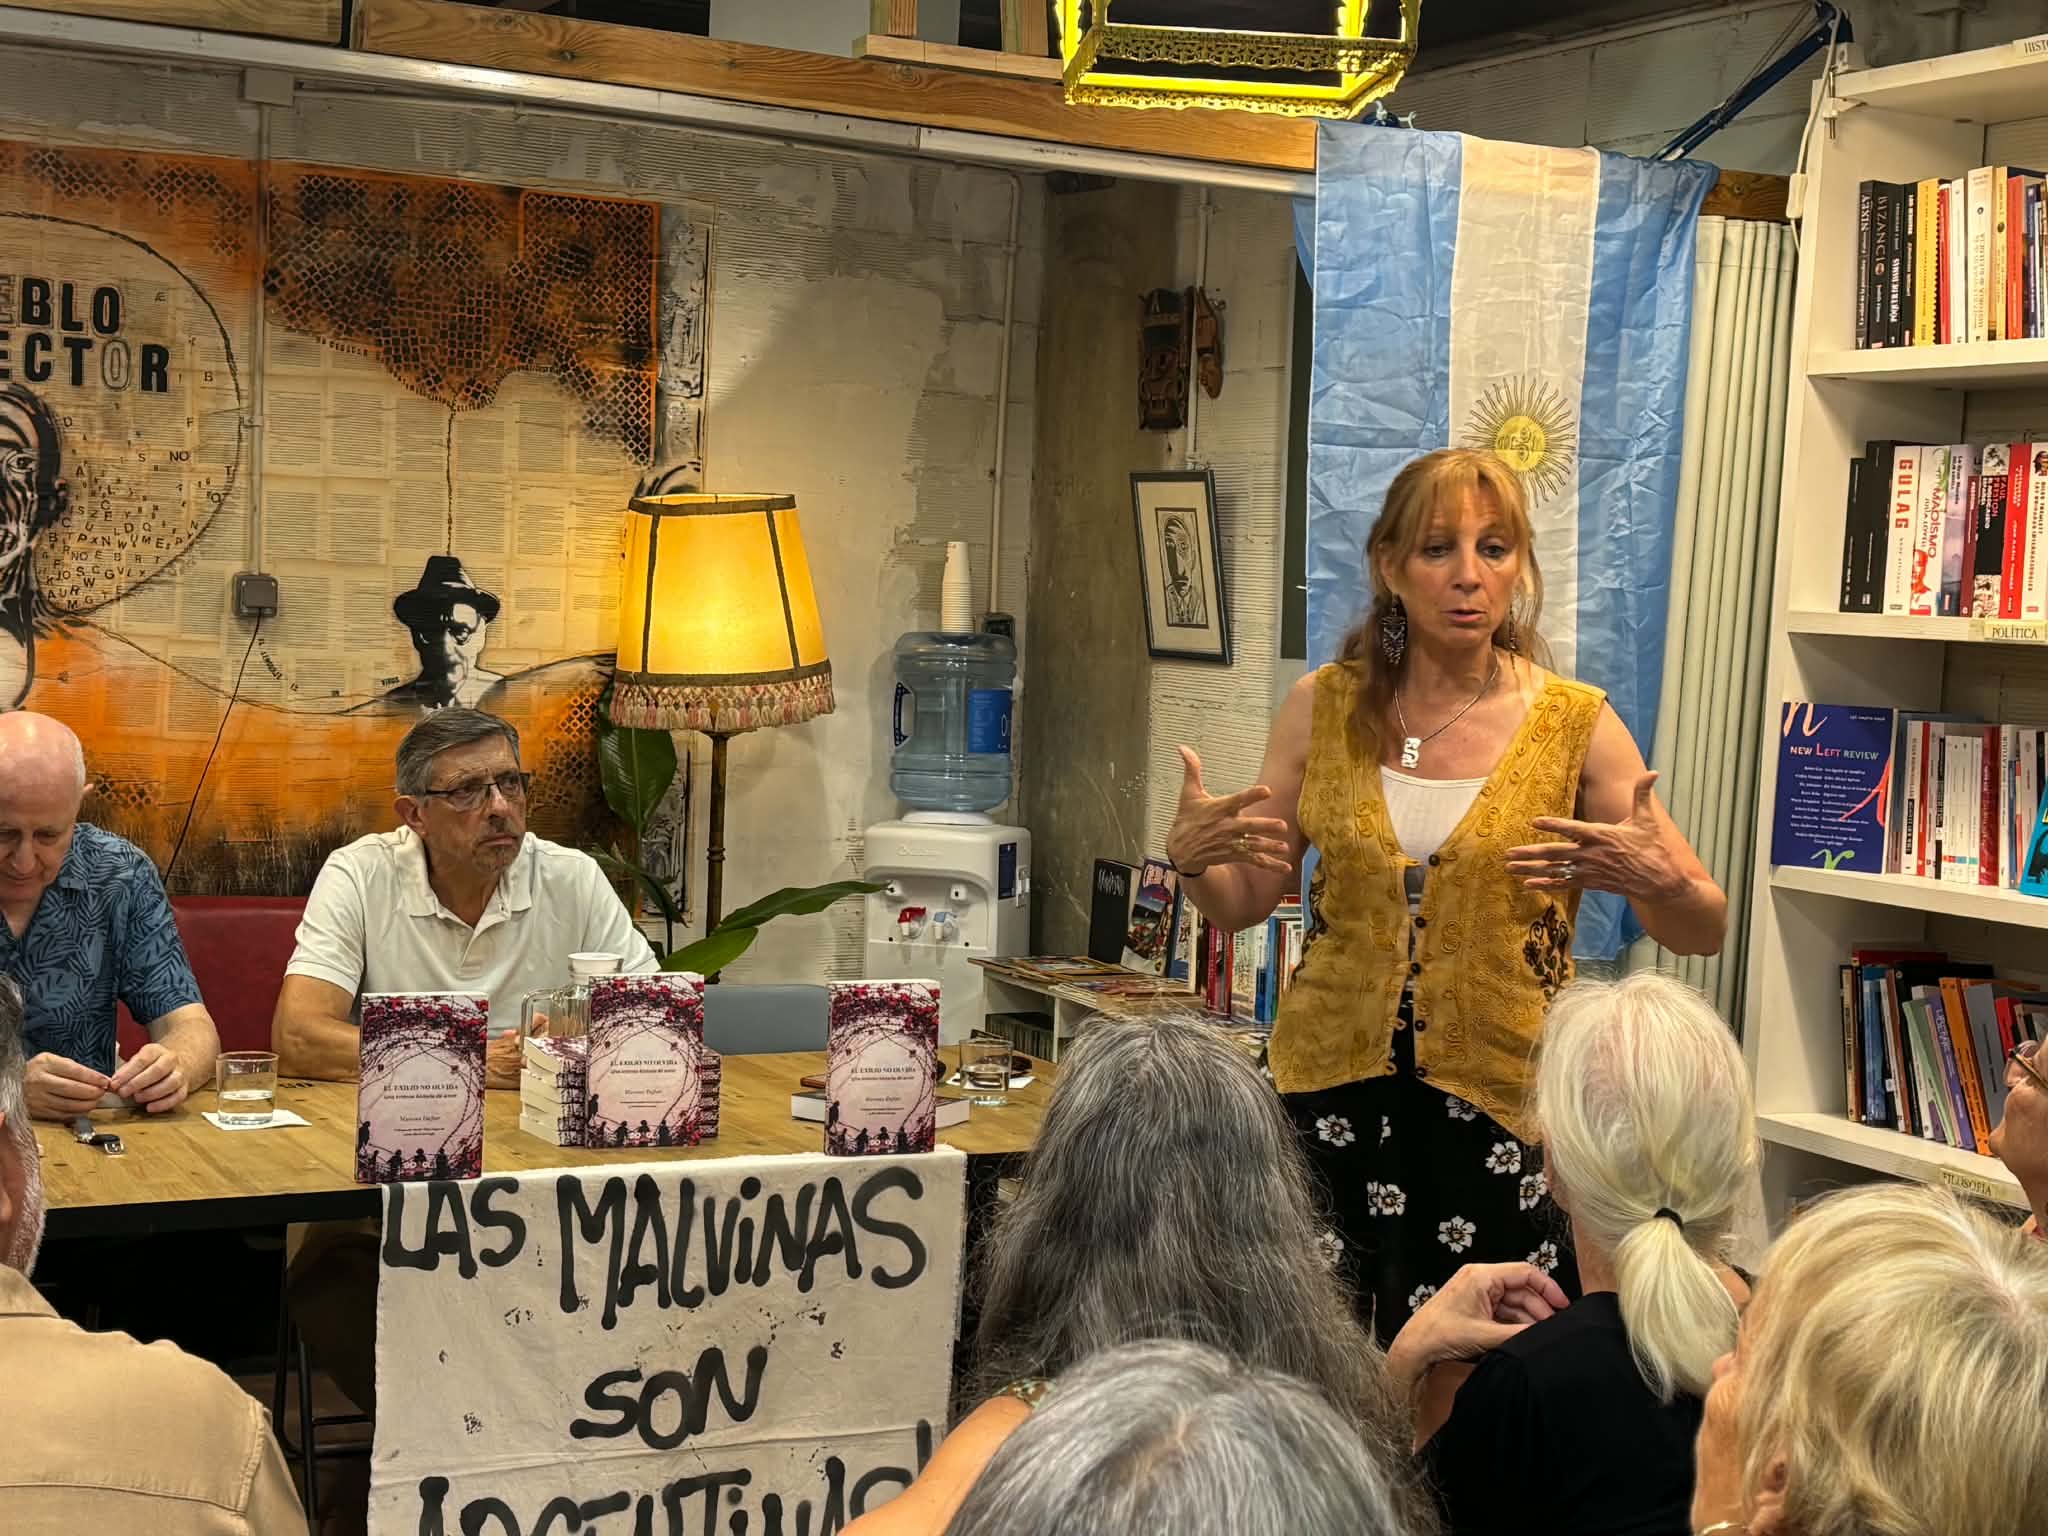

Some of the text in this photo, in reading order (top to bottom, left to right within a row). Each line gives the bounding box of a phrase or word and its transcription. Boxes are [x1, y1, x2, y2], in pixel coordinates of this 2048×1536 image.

[1895, 459, 1912, 529] GULAG
[1790, 746, 1813, 755] NEW
[1843, 750, 1880, 760] REVIEW
[382, 1176, 528, 1280] LAS
[569, 1345, 770, 1450] SON
